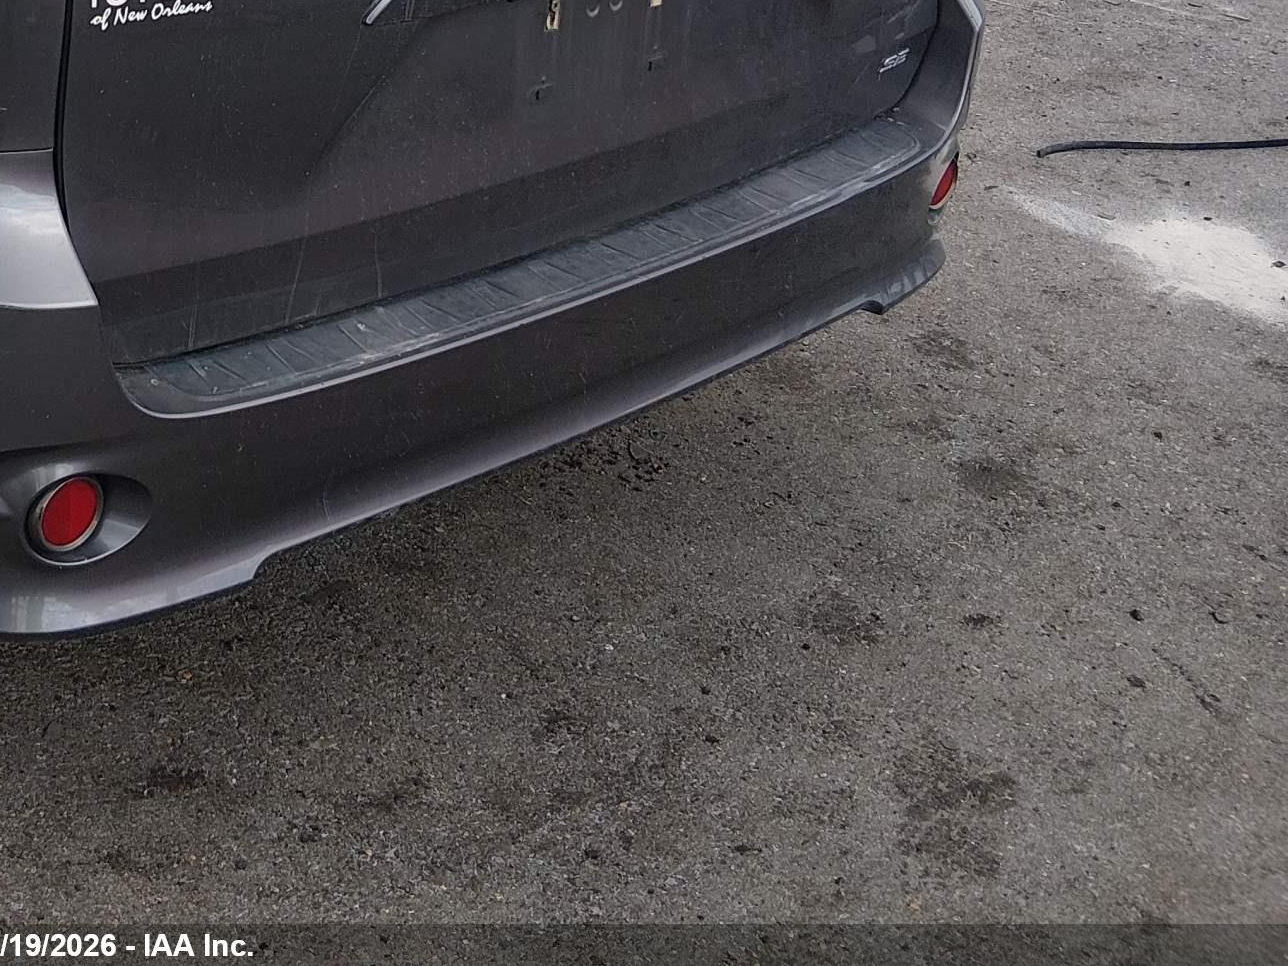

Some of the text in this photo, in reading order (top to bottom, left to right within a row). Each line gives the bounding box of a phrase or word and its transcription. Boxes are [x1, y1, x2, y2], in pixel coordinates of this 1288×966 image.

[90, 7, 111, 31] of
[113, 6, 148, 26] New
[879, 47, 910, 73] SE
